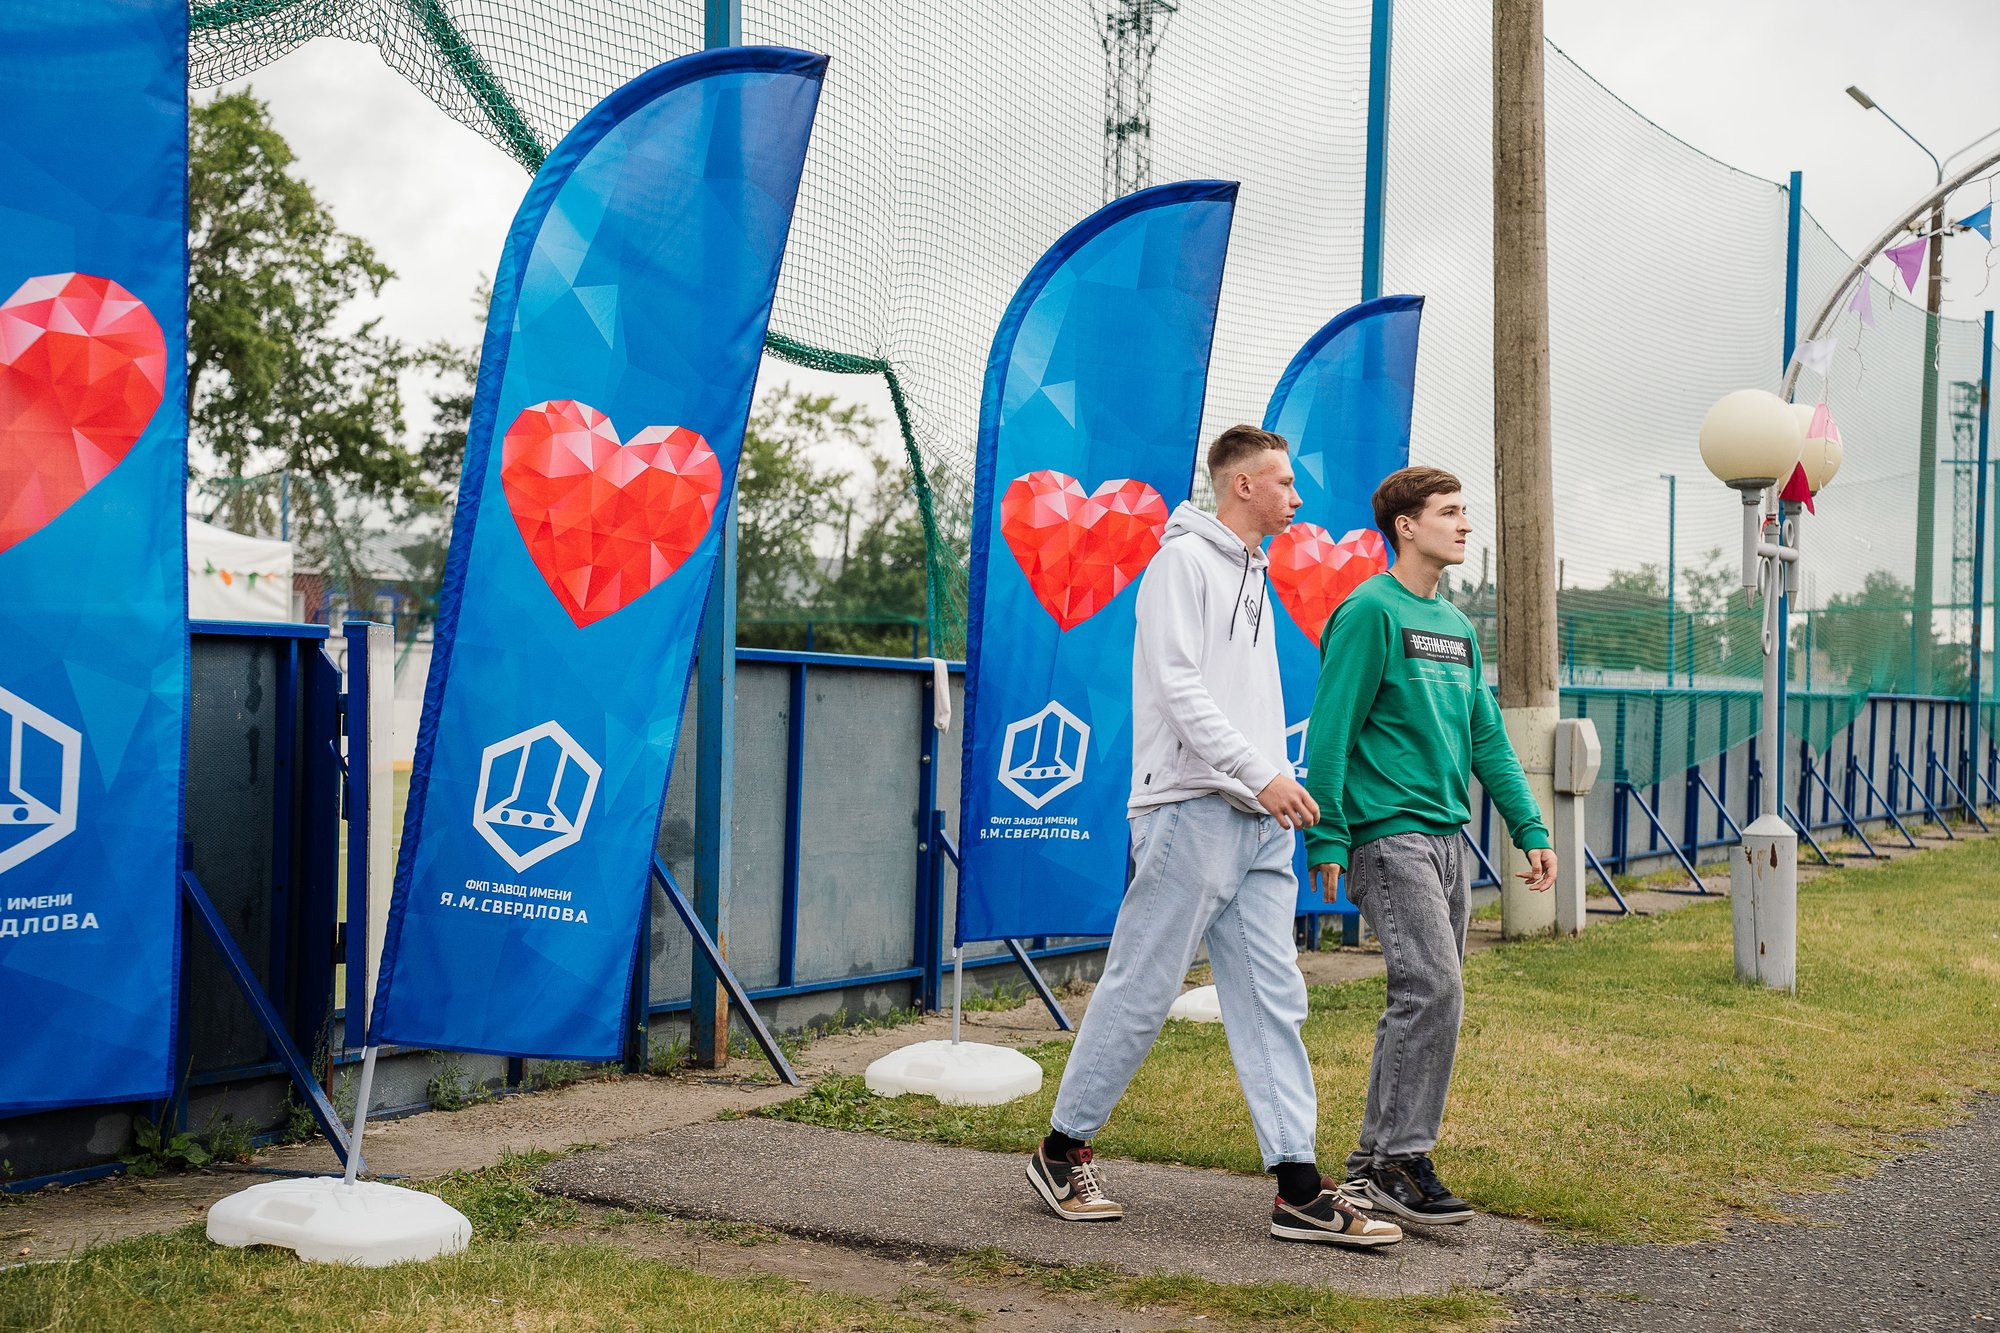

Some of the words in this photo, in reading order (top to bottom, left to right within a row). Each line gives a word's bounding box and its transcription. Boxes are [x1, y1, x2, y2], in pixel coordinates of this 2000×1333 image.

[1410, 634, 1467, 657] DESTINATIONS
[990, 816, 1012, 825] ФКП
[1013, 817, 1043, 825] ЗАВОД
[1044, 816, 1078, 825] ИМЕНИ
[980, 828, 1090, 840] Я.М.СВЕРДЛОВА
[465, 879, 490, 892] ФКП
[492, 882, 527, 898] ЗАВОД
[529, 886, 572, 902] ИМЕНИ
[7, 893, 73, 910] ИМЕНИ
[440, 891, 589, 924] Я.М.СВЕРДЛОВА
